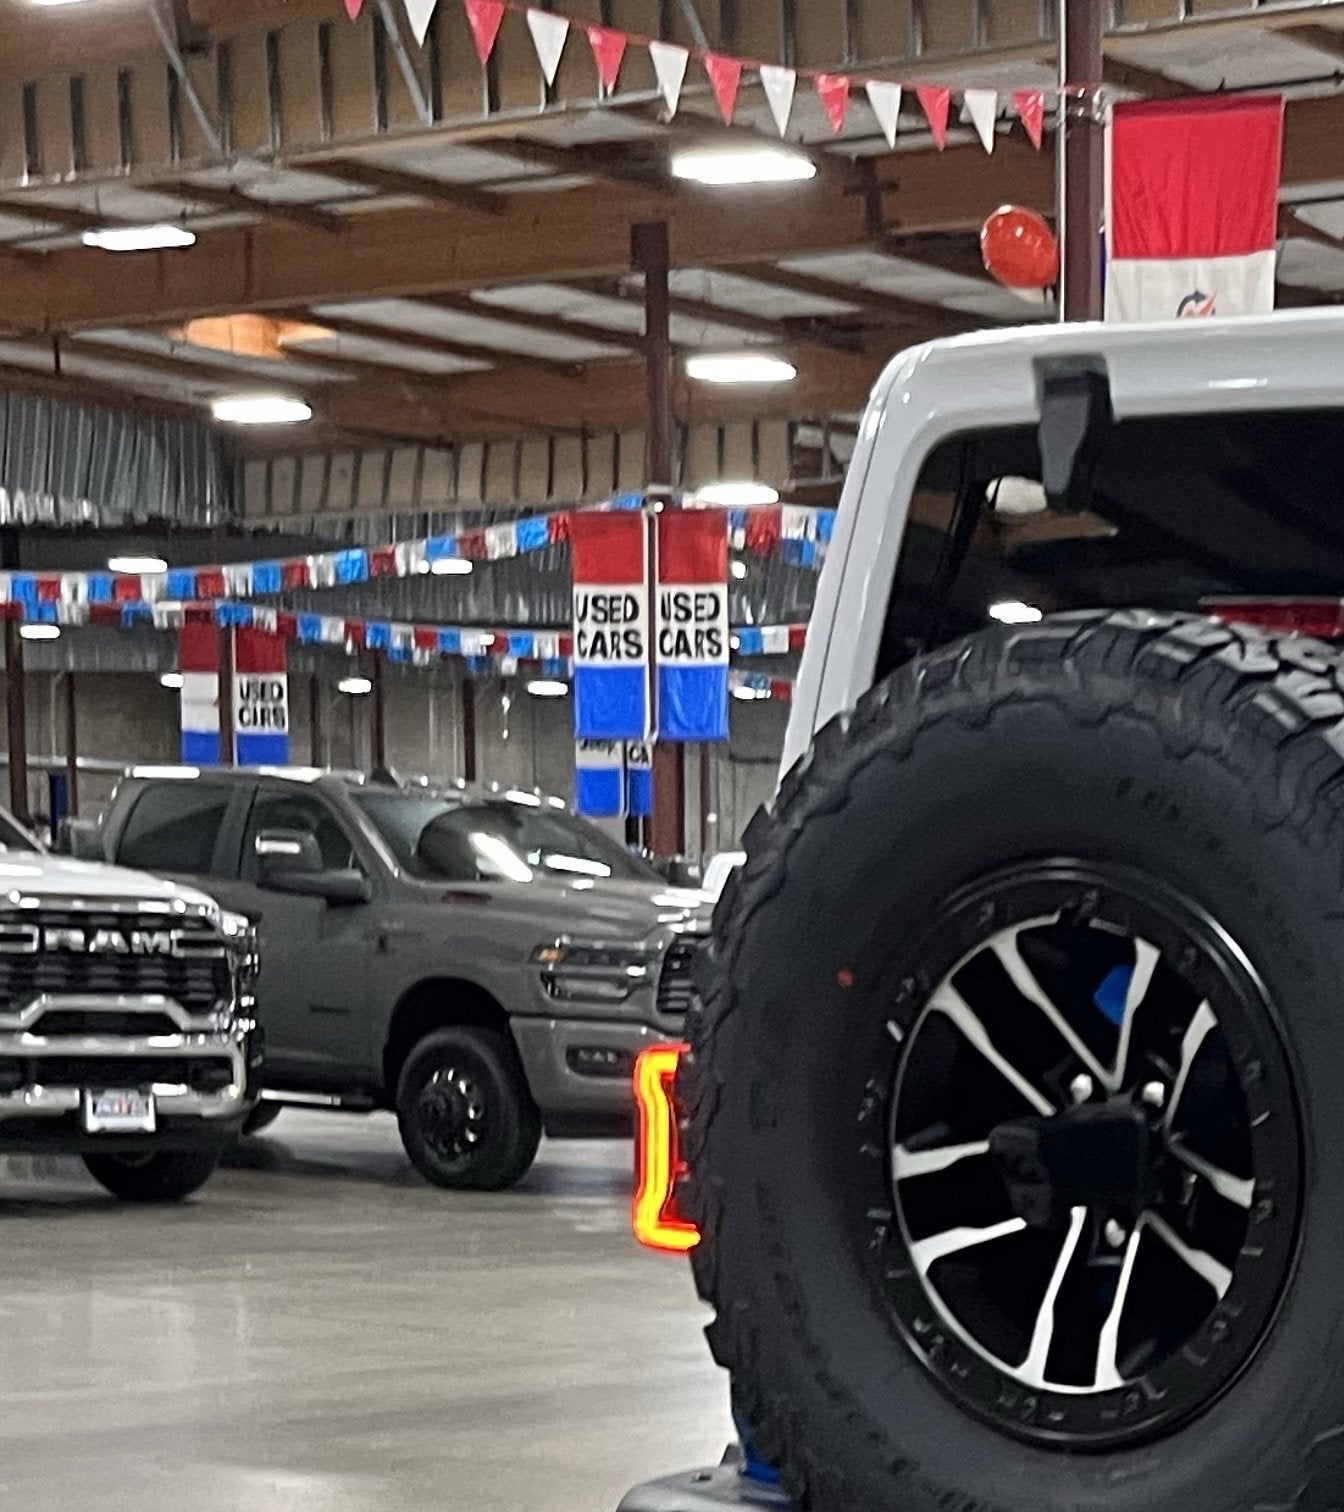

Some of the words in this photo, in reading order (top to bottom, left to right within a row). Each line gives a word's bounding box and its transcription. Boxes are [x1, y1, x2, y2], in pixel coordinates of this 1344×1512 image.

[576, 594, 640, 623] USED
[661, 592, 720, 623] USED
[577, 629, 643, 659] CARS
[659, 628, 722, 659] CARS
[239, 679, 284, 702] USED
[629, 744, 649, 764] CA
[44, 928, 170, 953] RAM
